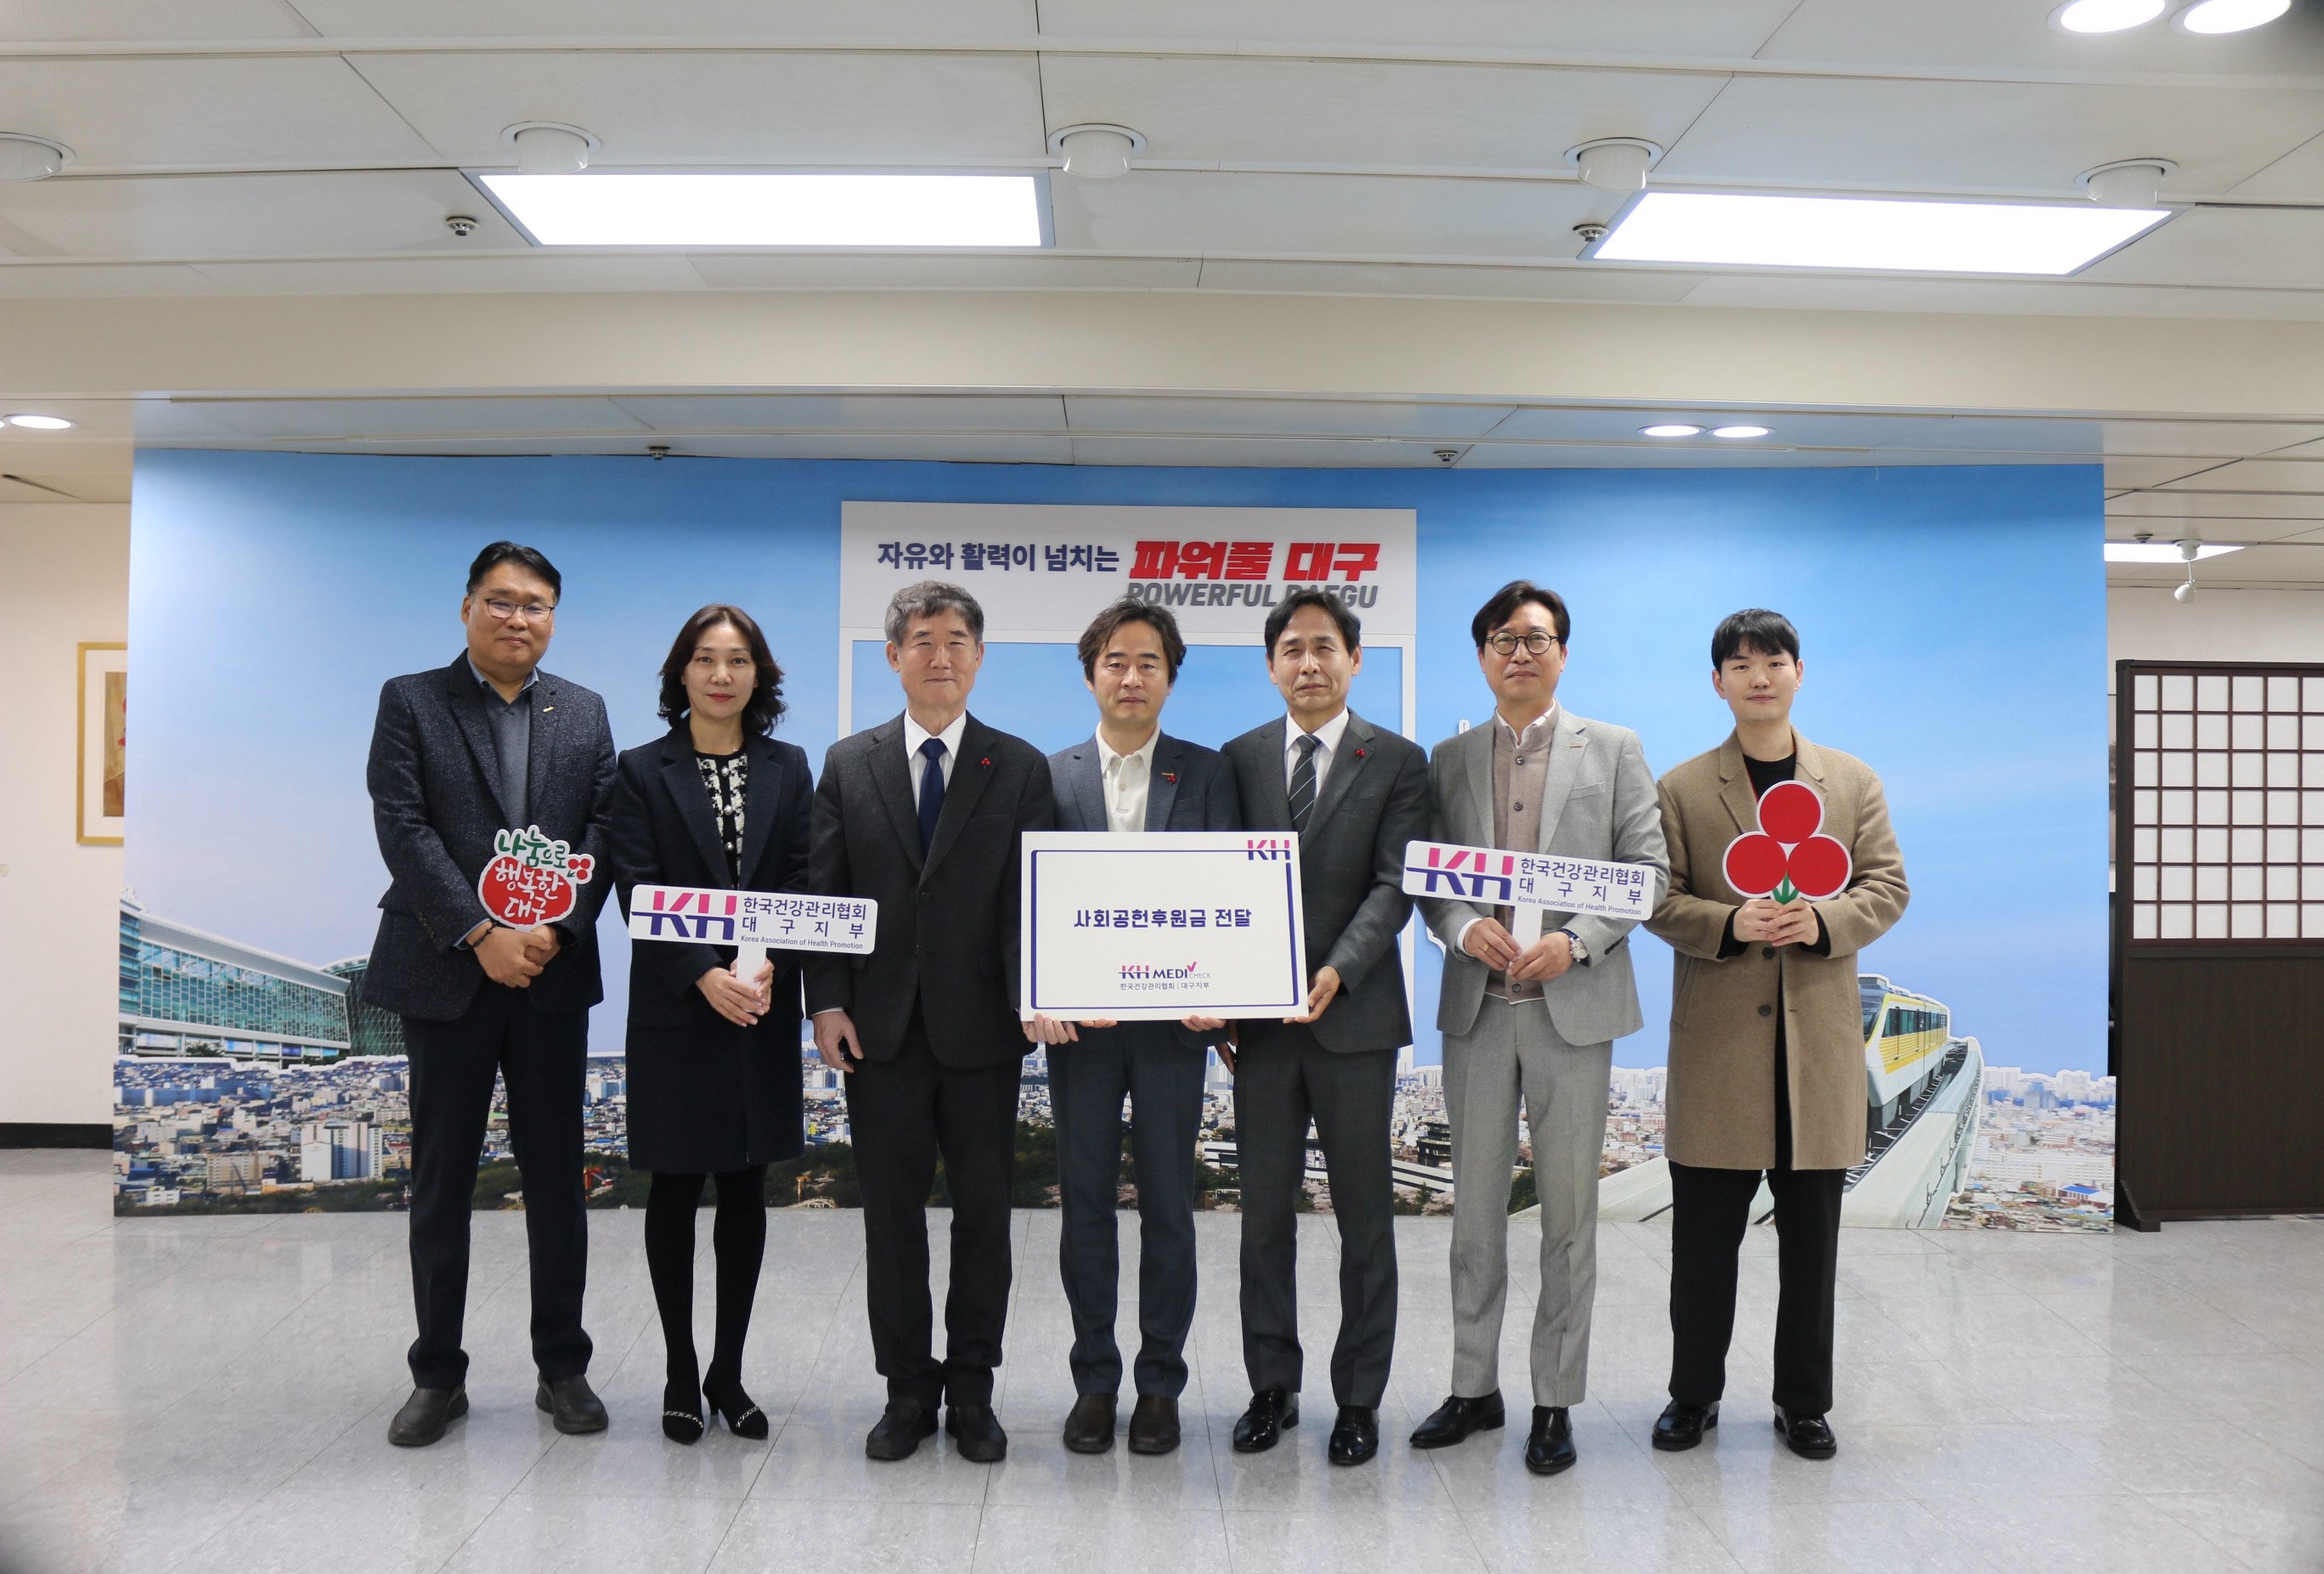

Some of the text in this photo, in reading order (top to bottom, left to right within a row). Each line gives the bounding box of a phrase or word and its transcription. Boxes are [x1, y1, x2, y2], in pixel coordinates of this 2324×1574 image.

[877, 541, 1380, 581] 자유와 활력이 넘치는 파워풀 대구
[1127, 582, 1277, 606] POWERFUL
[498, 829, 567, 868] 나눔으로
[1247, 839, 1290, 860] KH
[495, 860, 564, 900] 행복한
[1406, 847, 1515, 900] KH
[1520, 857, 1645, 887] 한국건강관리협회
[504, 896, 546, 922] 대구
[631, 891, 737, 940] KH
[743, 897, 866, 921] 한국건강관리협회
[1074, 909, 1251, 928] 사회공헌후원금 전달
[1537, 898, 1576, 908] Association
[1608, 905, 1642, 915] Promotion
[760, 936, 798, 945] Association
[1119, 965, 1149, 979] KH
